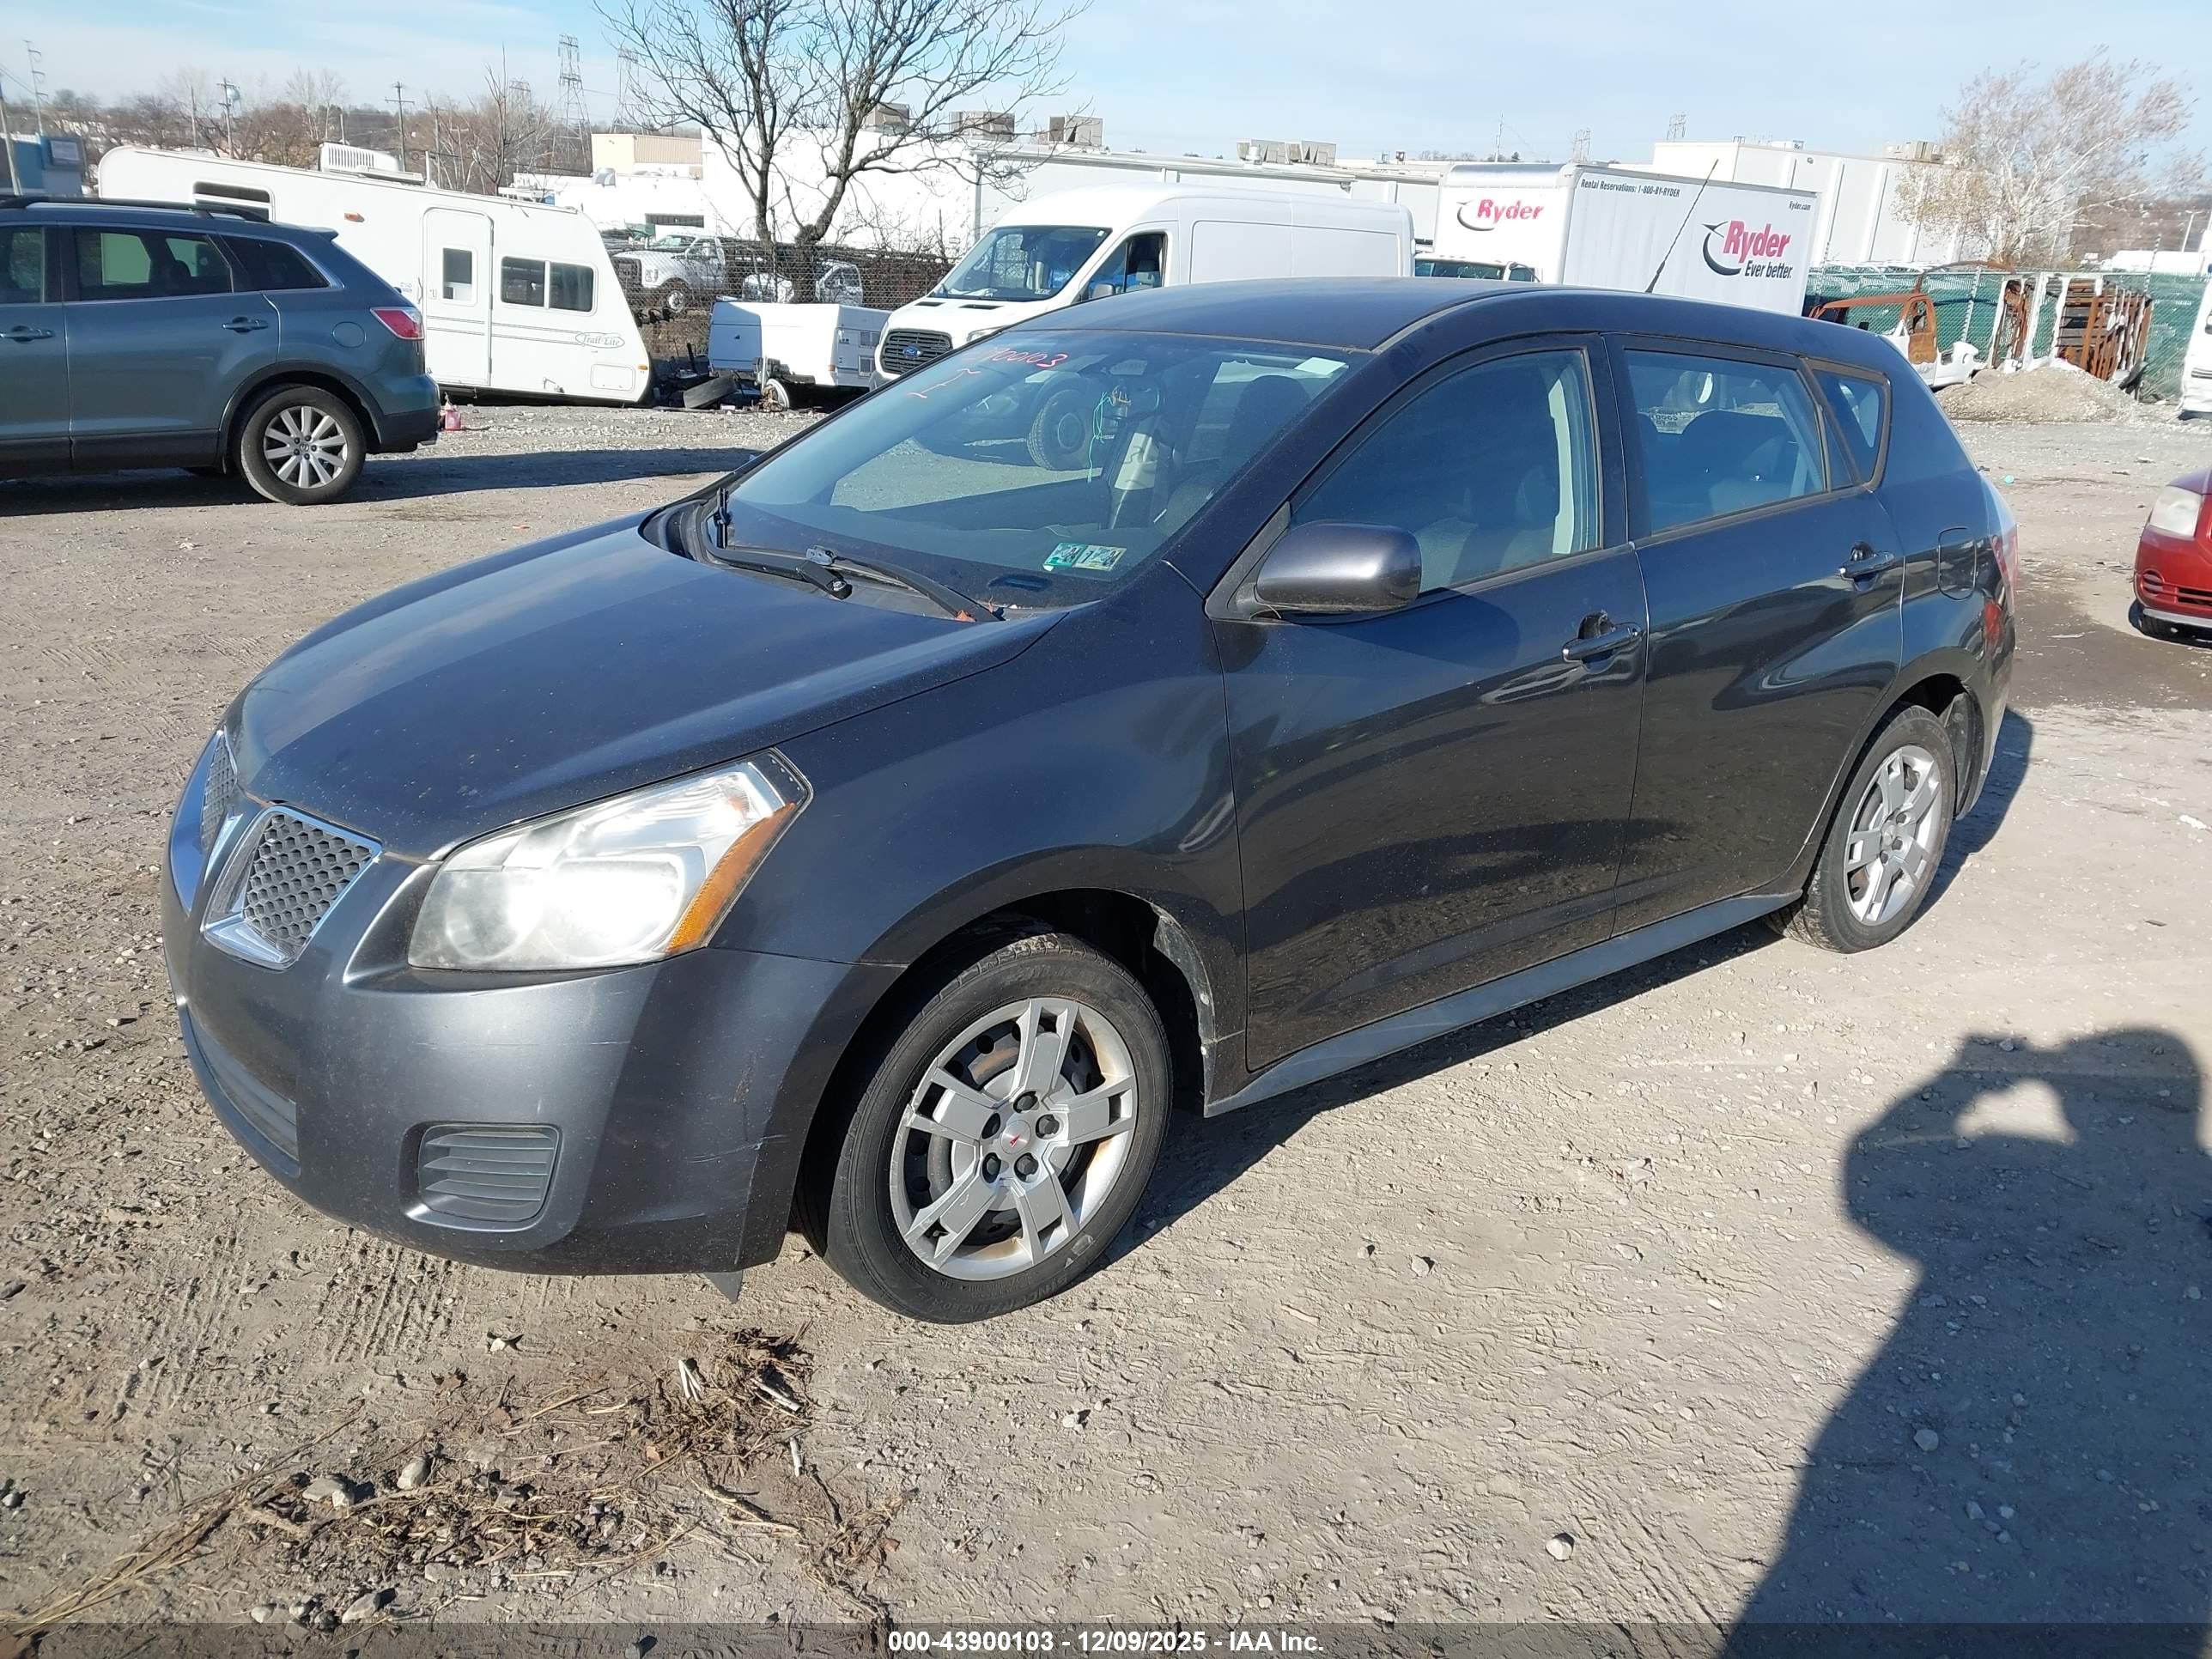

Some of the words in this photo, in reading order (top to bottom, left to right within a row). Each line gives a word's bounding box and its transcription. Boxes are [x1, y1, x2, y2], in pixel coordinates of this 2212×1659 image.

[1580, 179, 1599, 189] Rental
[1600, 180, 1637, 193] Reservations:
[1638, 185, 1680, 198] 1-800-BY-RYDER
[1477, 199, 1544, 224] Ryder
[1723, 220, 1791, 264] Ryder
[1744, 260, 1766, 278] Ever
[1765, 262, 1793, 279] better.
